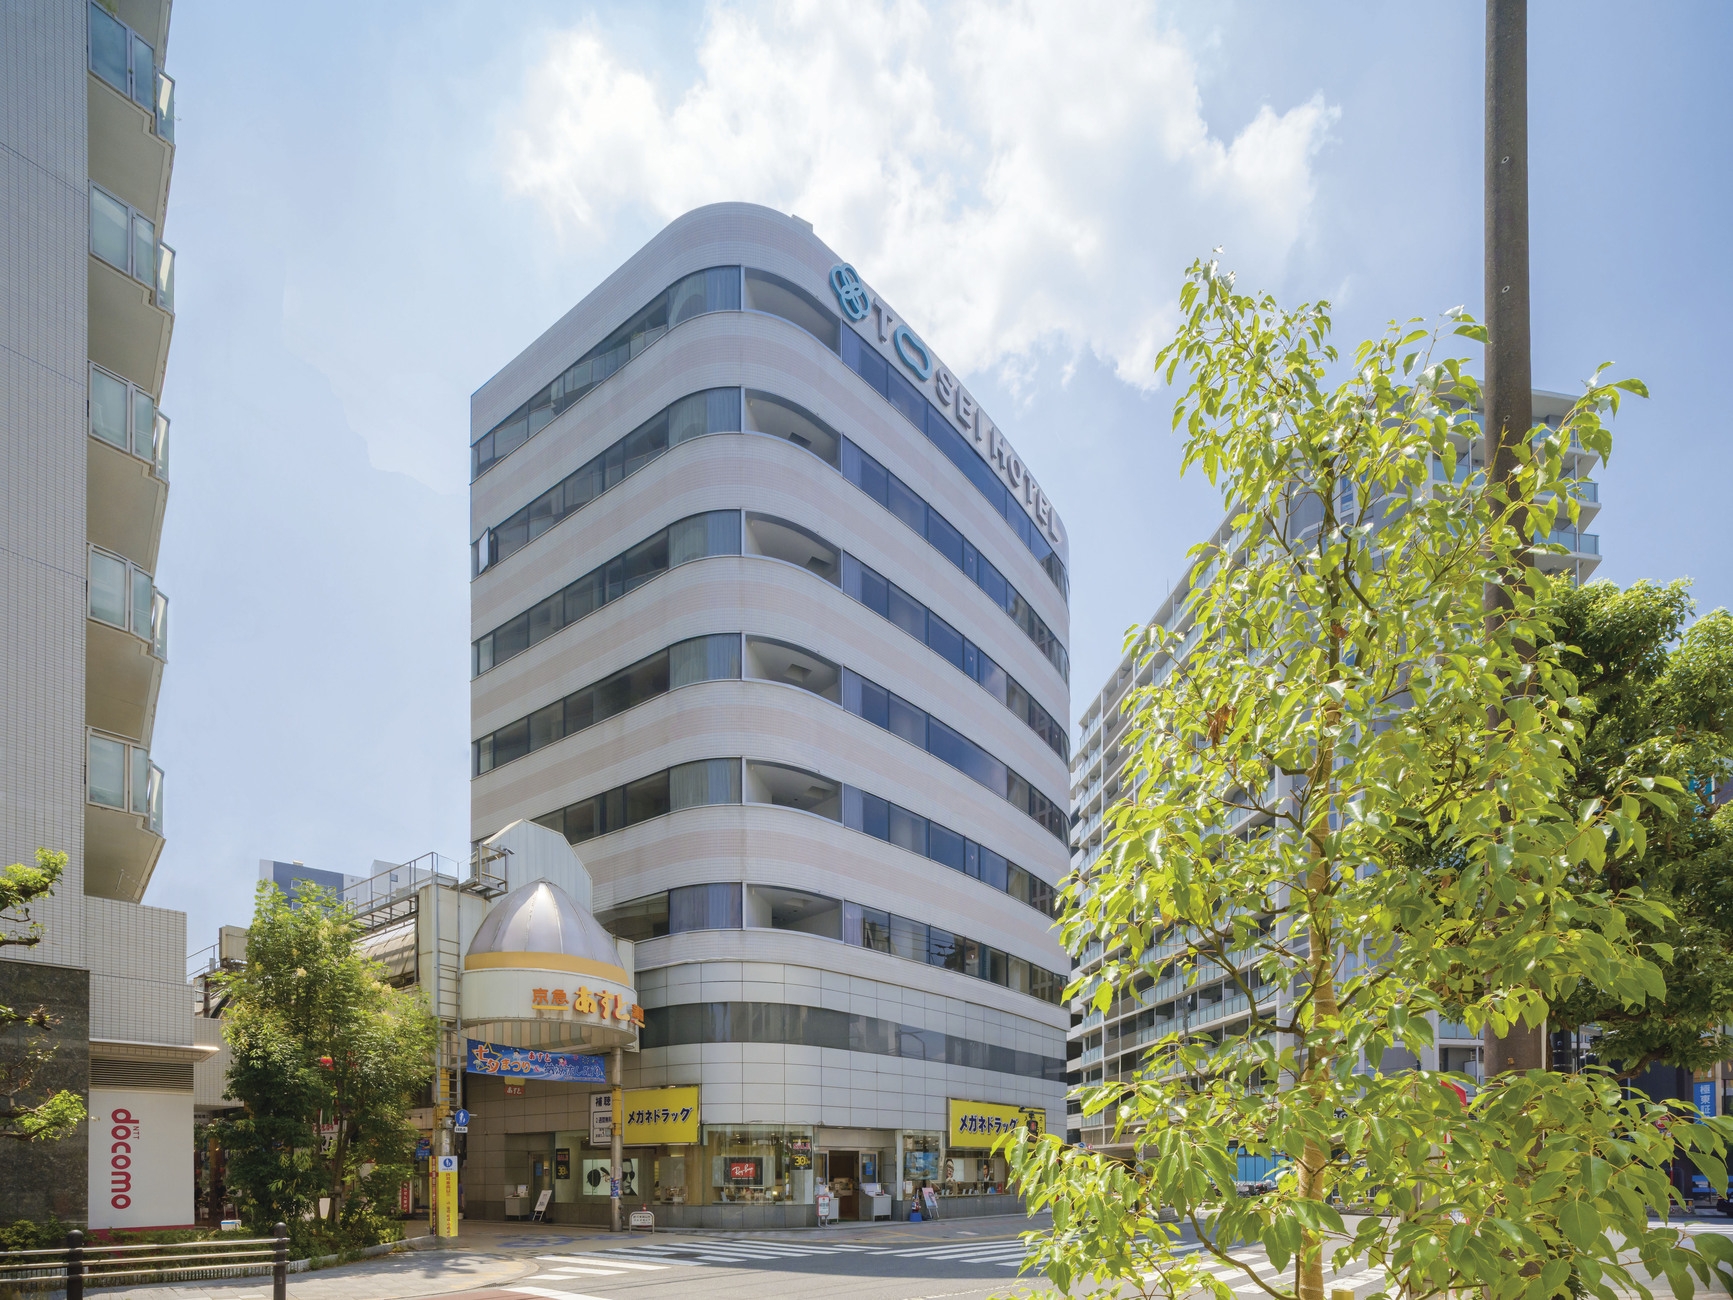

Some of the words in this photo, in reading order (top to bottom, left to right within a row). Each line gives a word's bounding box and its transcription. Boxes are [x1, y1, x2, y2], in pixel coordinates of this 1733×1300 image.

[990, 427, 1058, 543] HOTEL
[472, 1045, 531, 1073] 七夕まつり
[528, 1051, 551, 1062] あすと
[595, 1096, 611, 1107] 補聴
[1700, 1084, 1711, 1117] 極東証
[627, 1107, 692, 1124] メガネドラッグ
[959, 1114, 1018, 1134] メガネドラッグ
[111, 1108, 140, 1210] docomo
